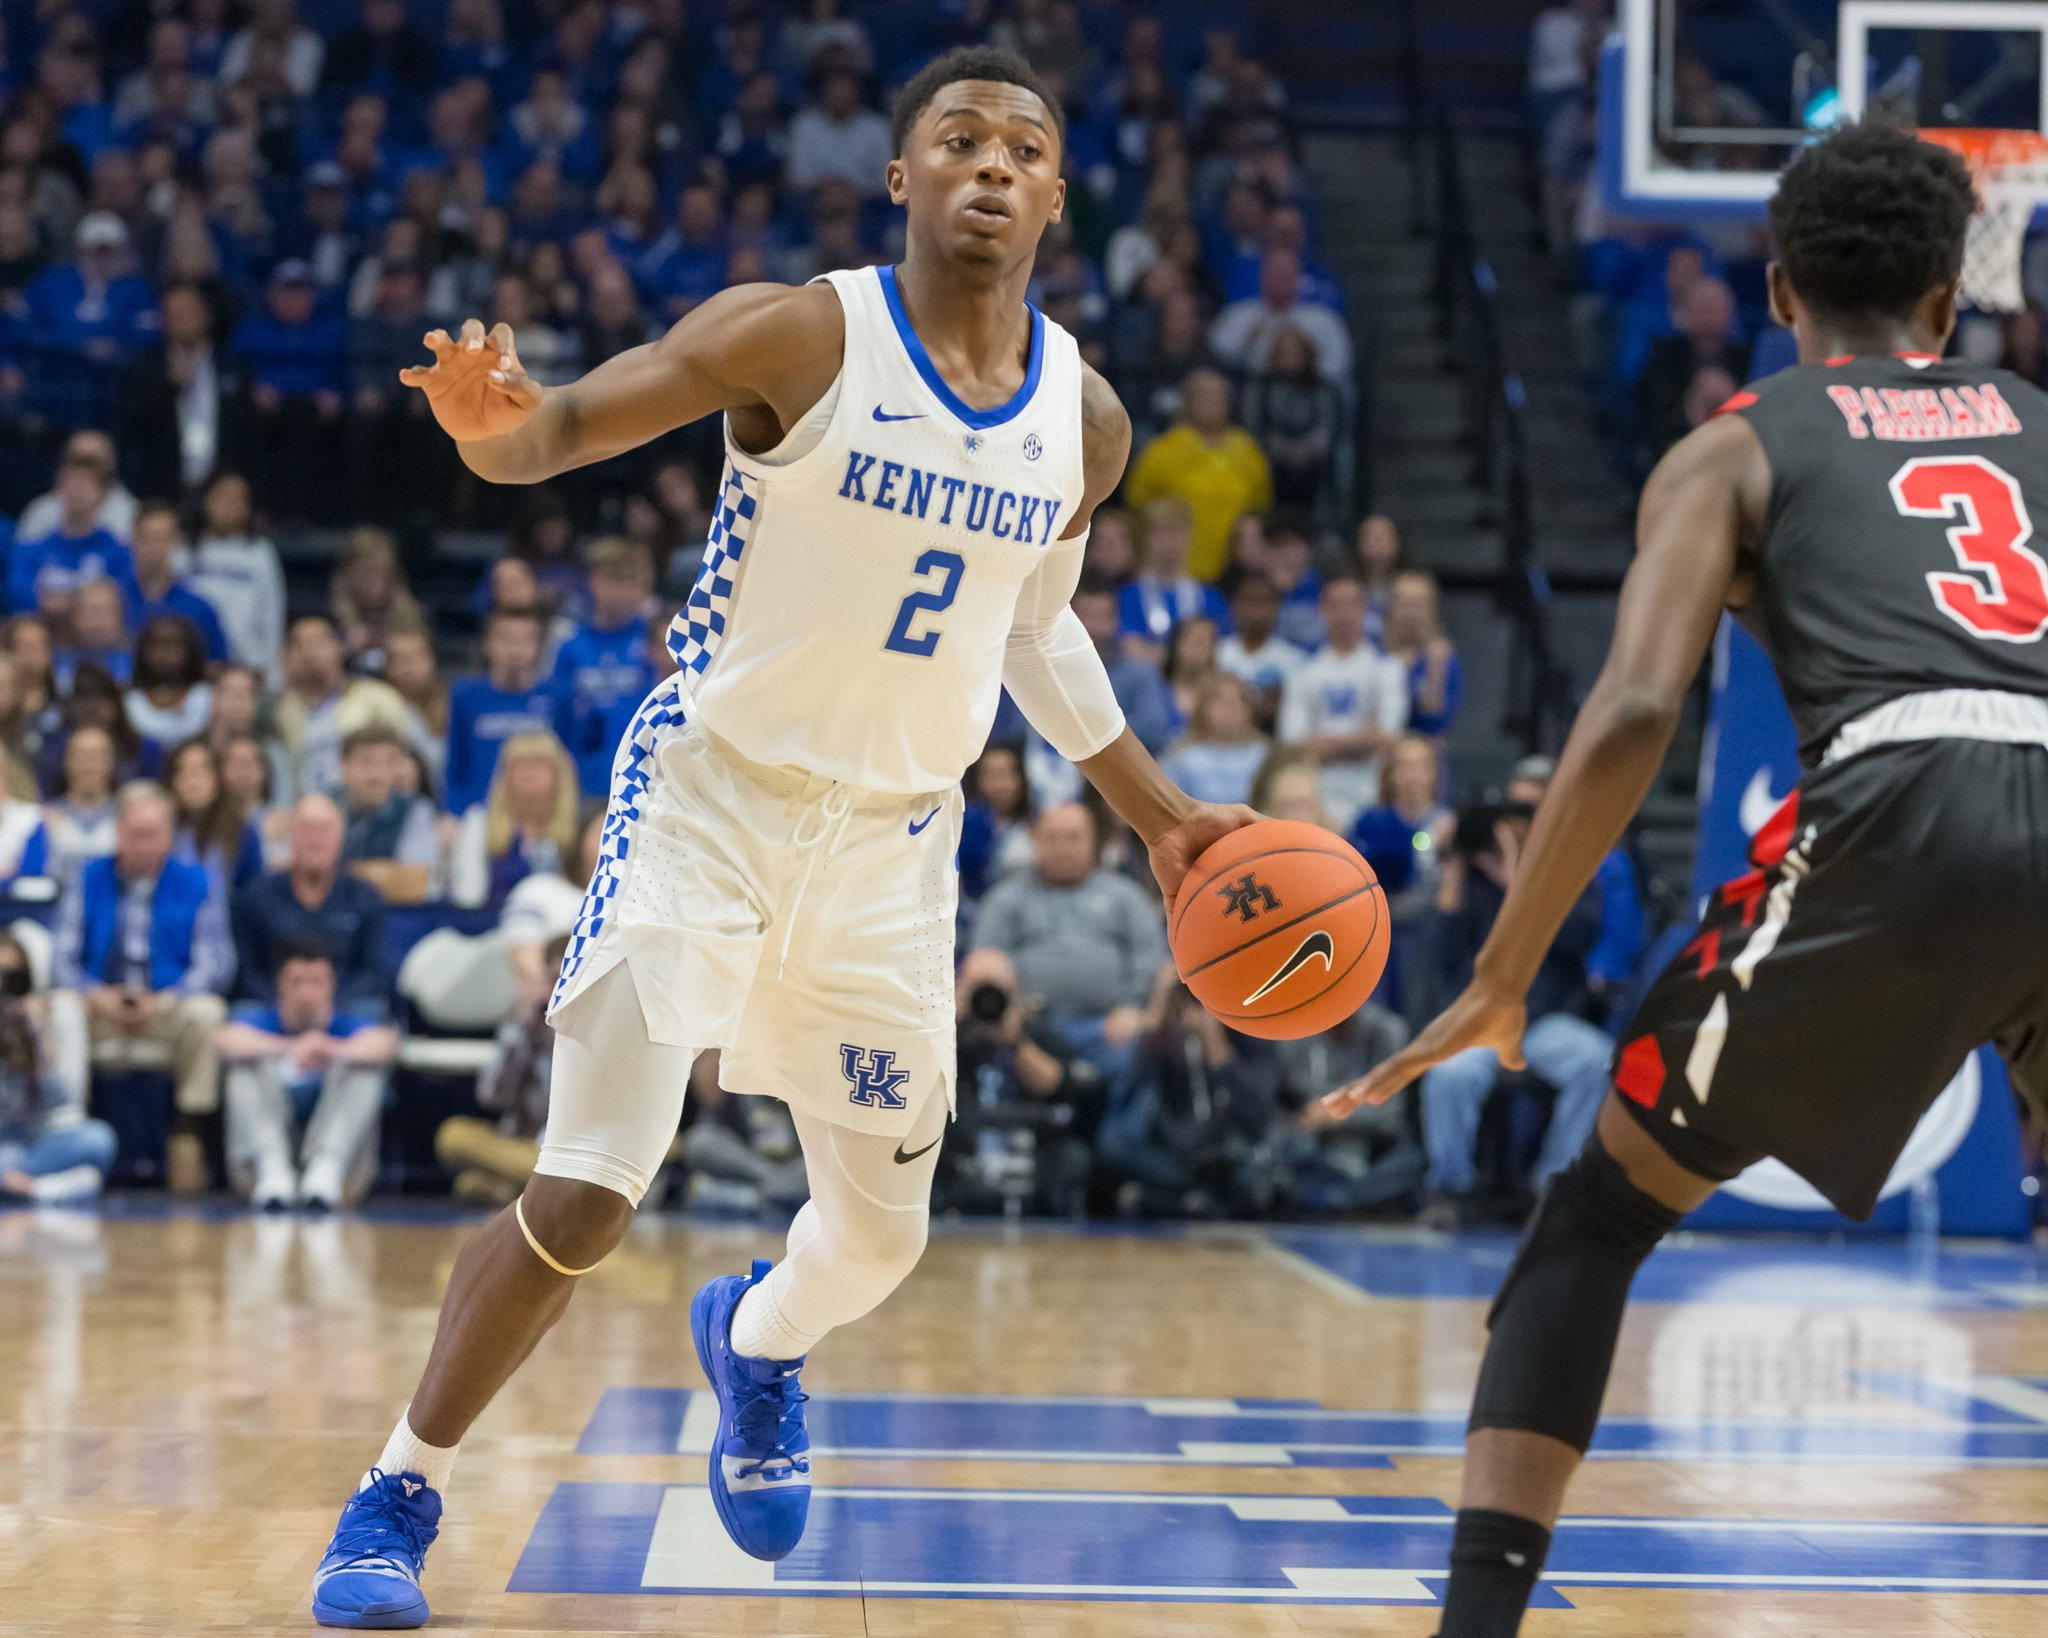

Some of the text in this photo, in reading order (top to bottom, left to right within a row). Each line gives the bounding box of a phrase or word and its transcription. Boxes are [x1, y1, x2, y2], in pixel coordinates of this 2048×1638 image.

[1024, 434, 1042, 460] SEC
[838, 450, 1062, 546] KENTUCKY
[1888, 455, 2048, 644] 3
[882, 547, 967, 659] 2
[840, 1043, 909, 1109] UK
